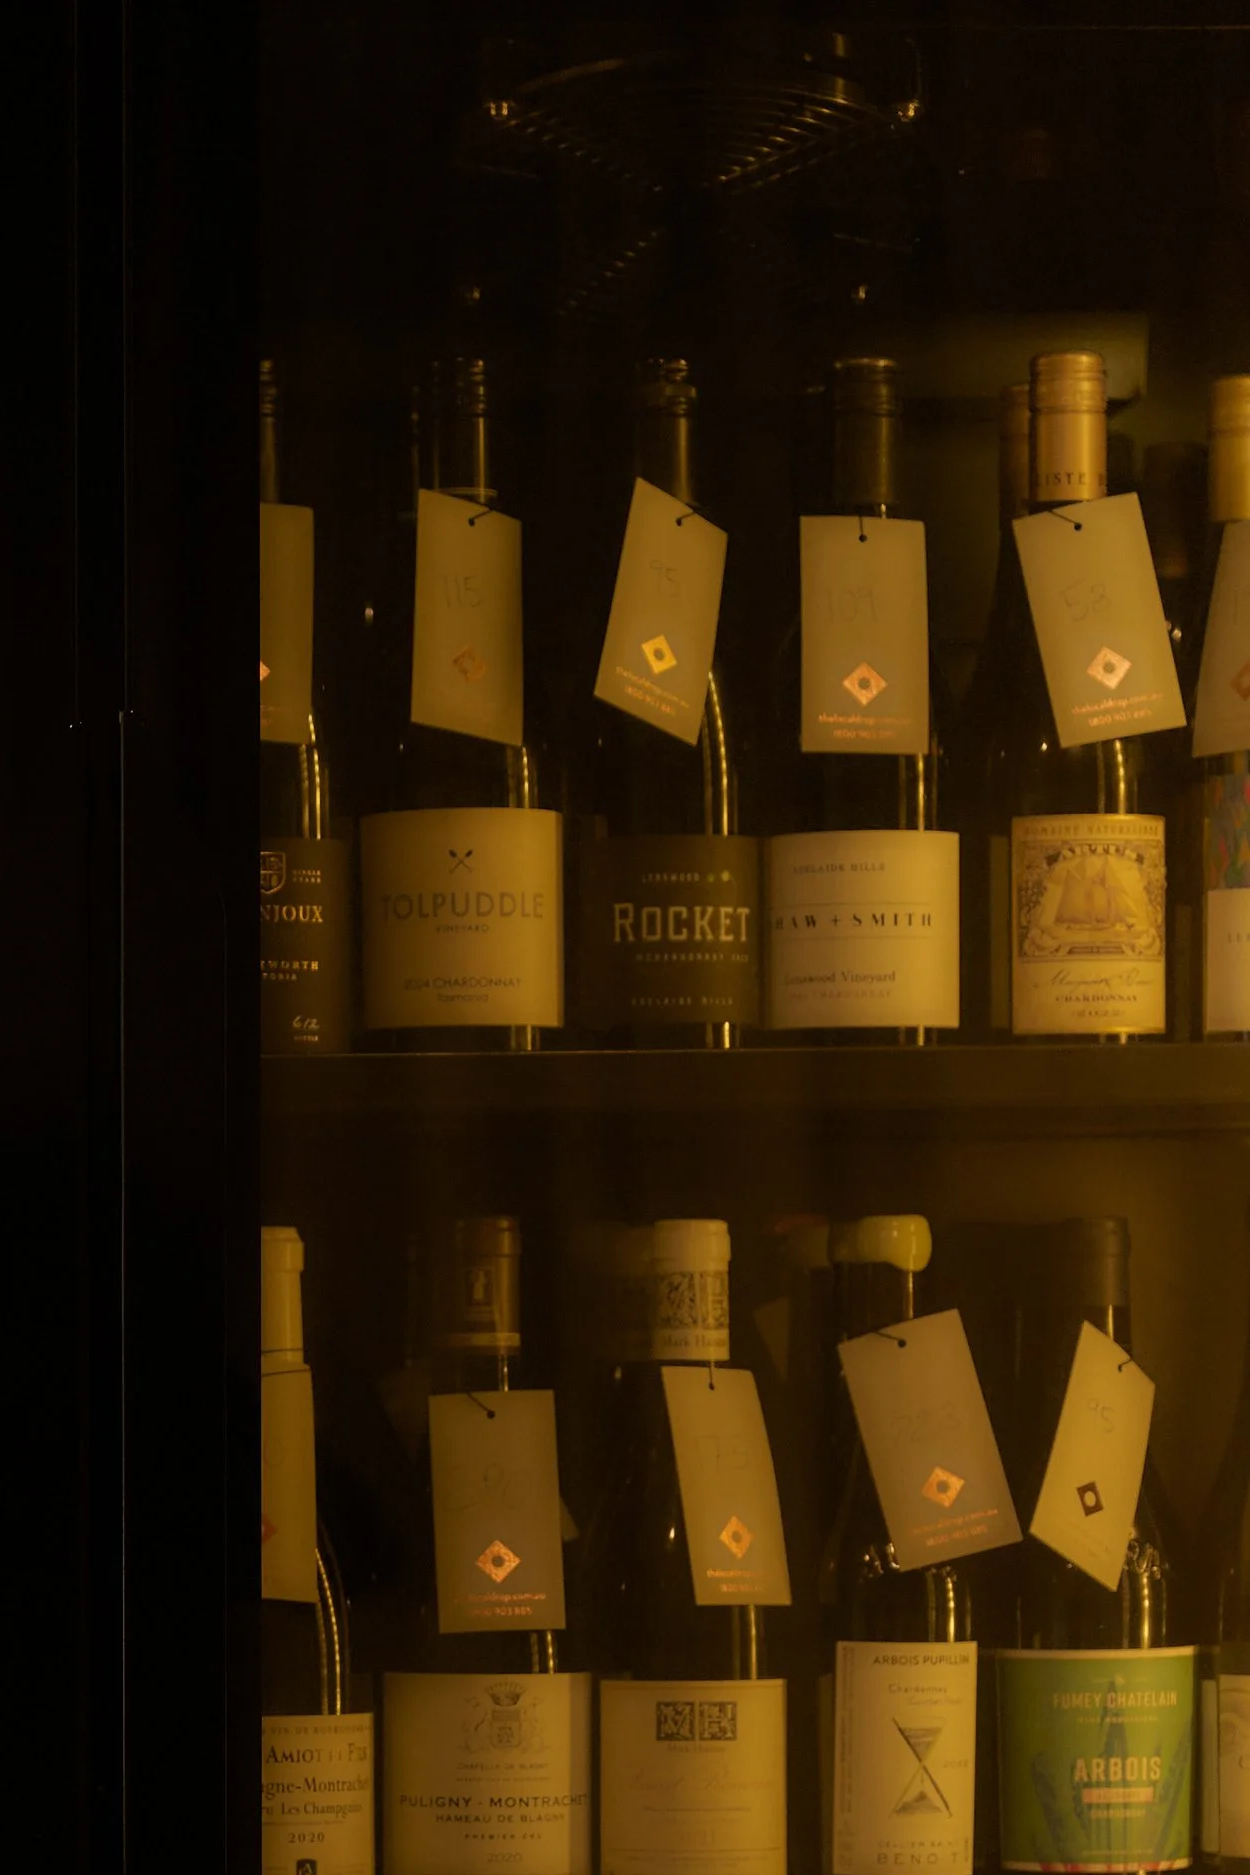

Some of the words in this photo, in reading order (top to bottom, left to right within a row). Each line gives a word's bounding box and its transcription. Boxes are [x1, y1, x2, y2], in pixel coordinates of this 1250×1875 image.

[380, 890, 544, 922] TOLPUDDLE
[613, 901, 751, 943] ROCKET
[851, 912, 933, 930] SMITH
[433, 974, 522, 990] CHARDONNAY
[841, 968, 898, 985] Vineyard
[872, 1654, 920, 1667] ARBOIS
[1052, 1692, 1102, 1710] FUMEY
[1106, 1690, 1178, 1709] CHATELAIN
[266, 1744, 322, 1765] AMIOT
[1074, 1756, 1163, 1782] ARBOIS
[281, 1801, 301, 1816] Les
[400, 1794, 472, 1809] PULIGNY
[435, 1813, 492, 1823] HAMEAU
[497, 1813, 515, 1823] DE
[287, 1831, 326, 1844] 2020
[486, 1851, 524, 1864] 2020
[876, 1851, 960, 1866] BENOT
